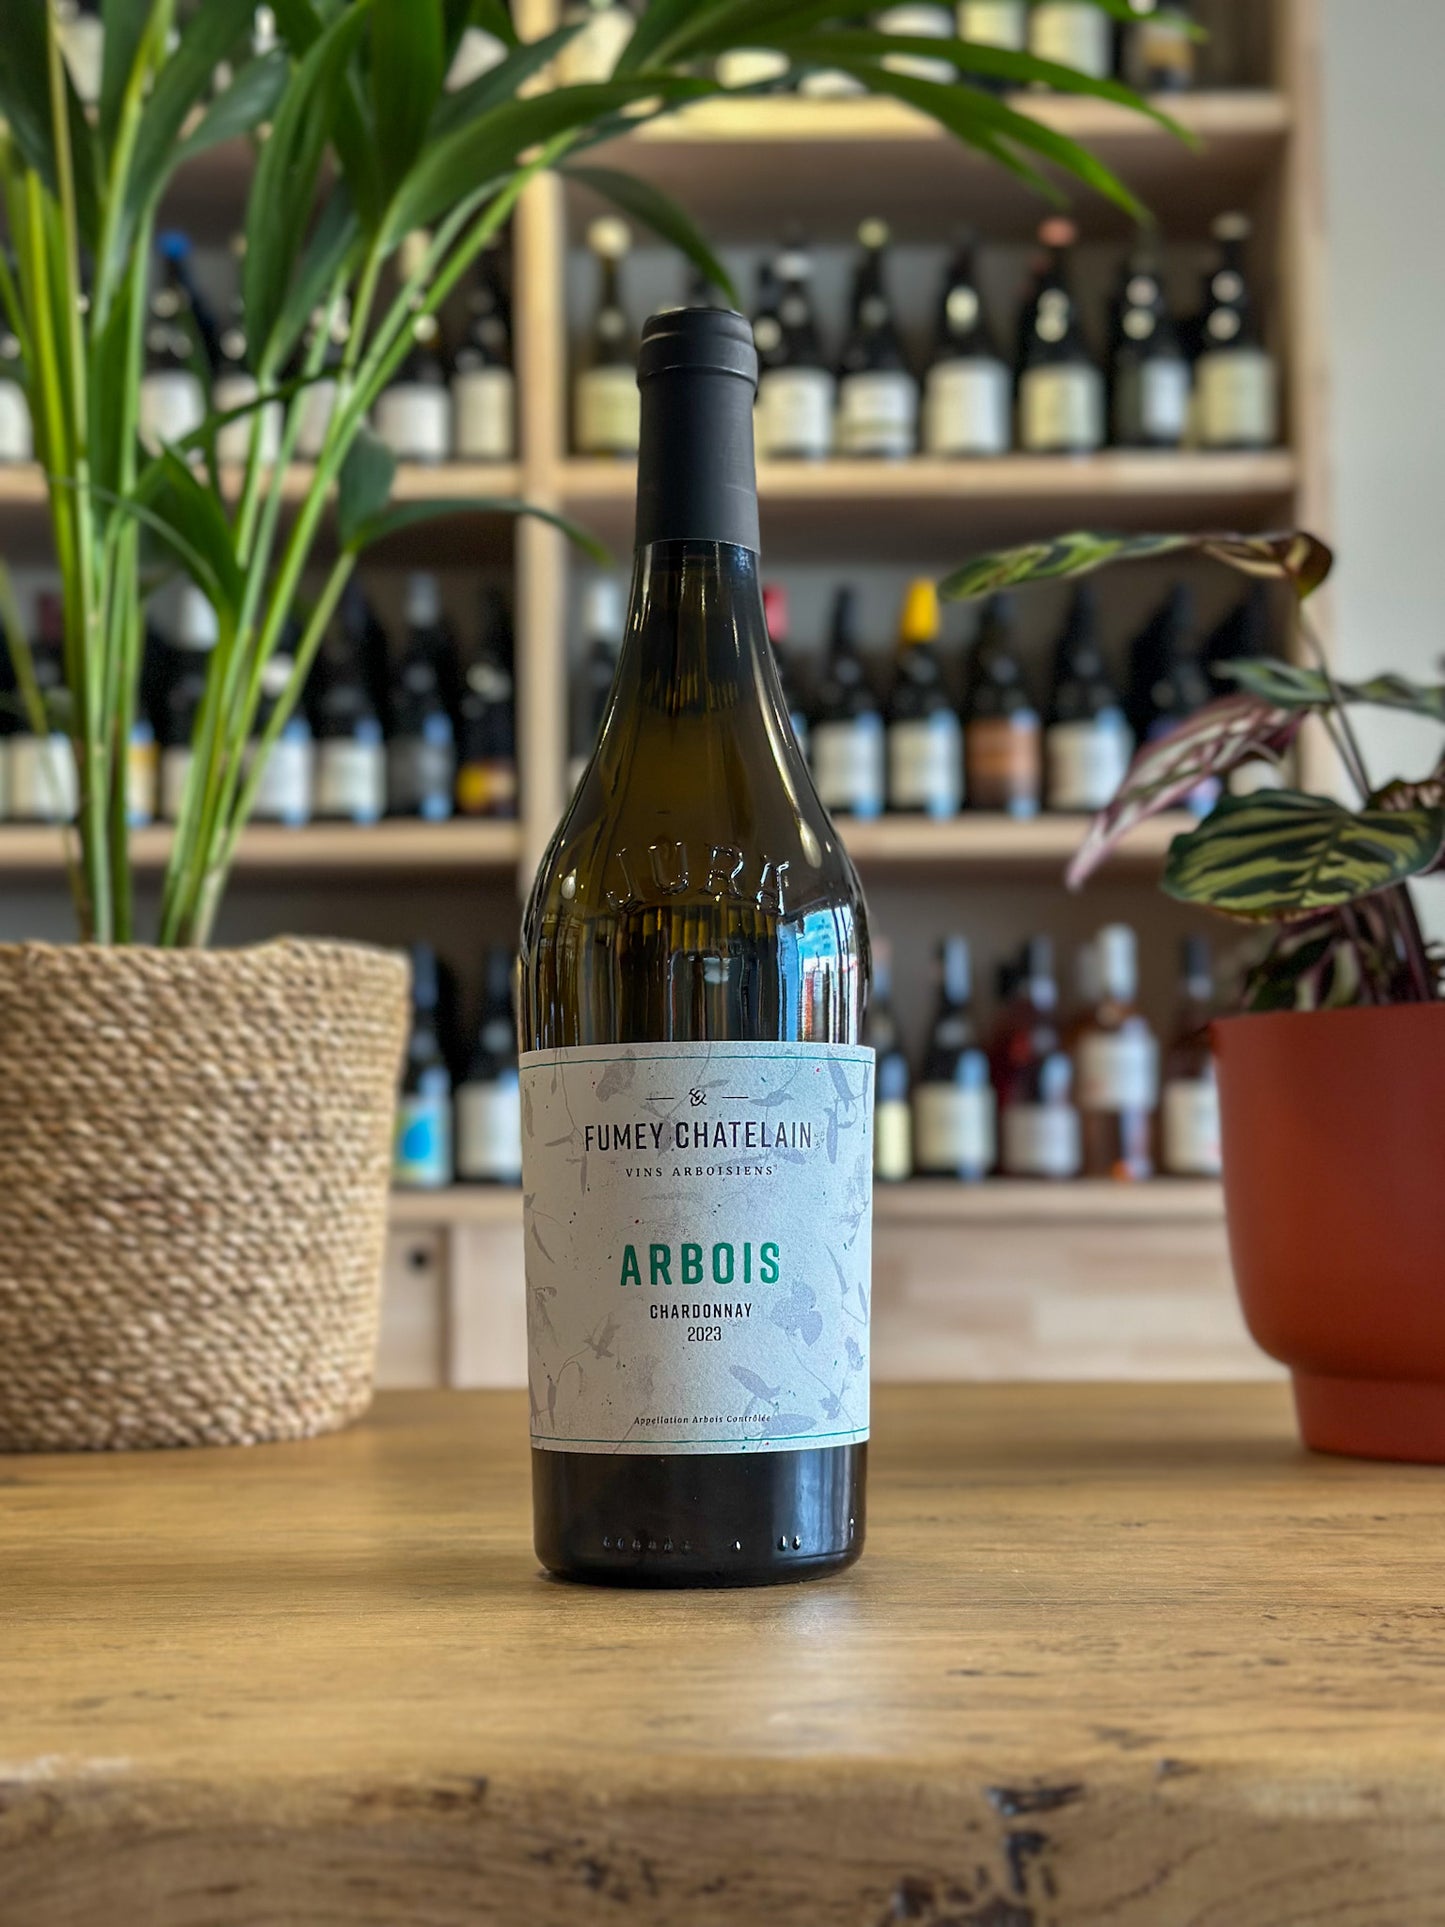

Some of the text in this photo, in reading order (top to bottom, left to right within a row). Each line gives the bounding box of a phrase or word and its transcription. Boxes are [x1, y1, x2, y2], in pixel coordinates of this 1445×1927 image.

[584, 1121, 812, 1151] FUMEY CHATELAIN
[625, 1165, 774, 1177] VINS ARBOISIENS
[620, 1242, 780, 1286] ARBOIS
[650, 1302, 753, 1319] CHARDONNAY
[687, 1326, 722, 1342] 2023
[633, 1413, 772, 1427] Appellation Arbois Contrôlée
